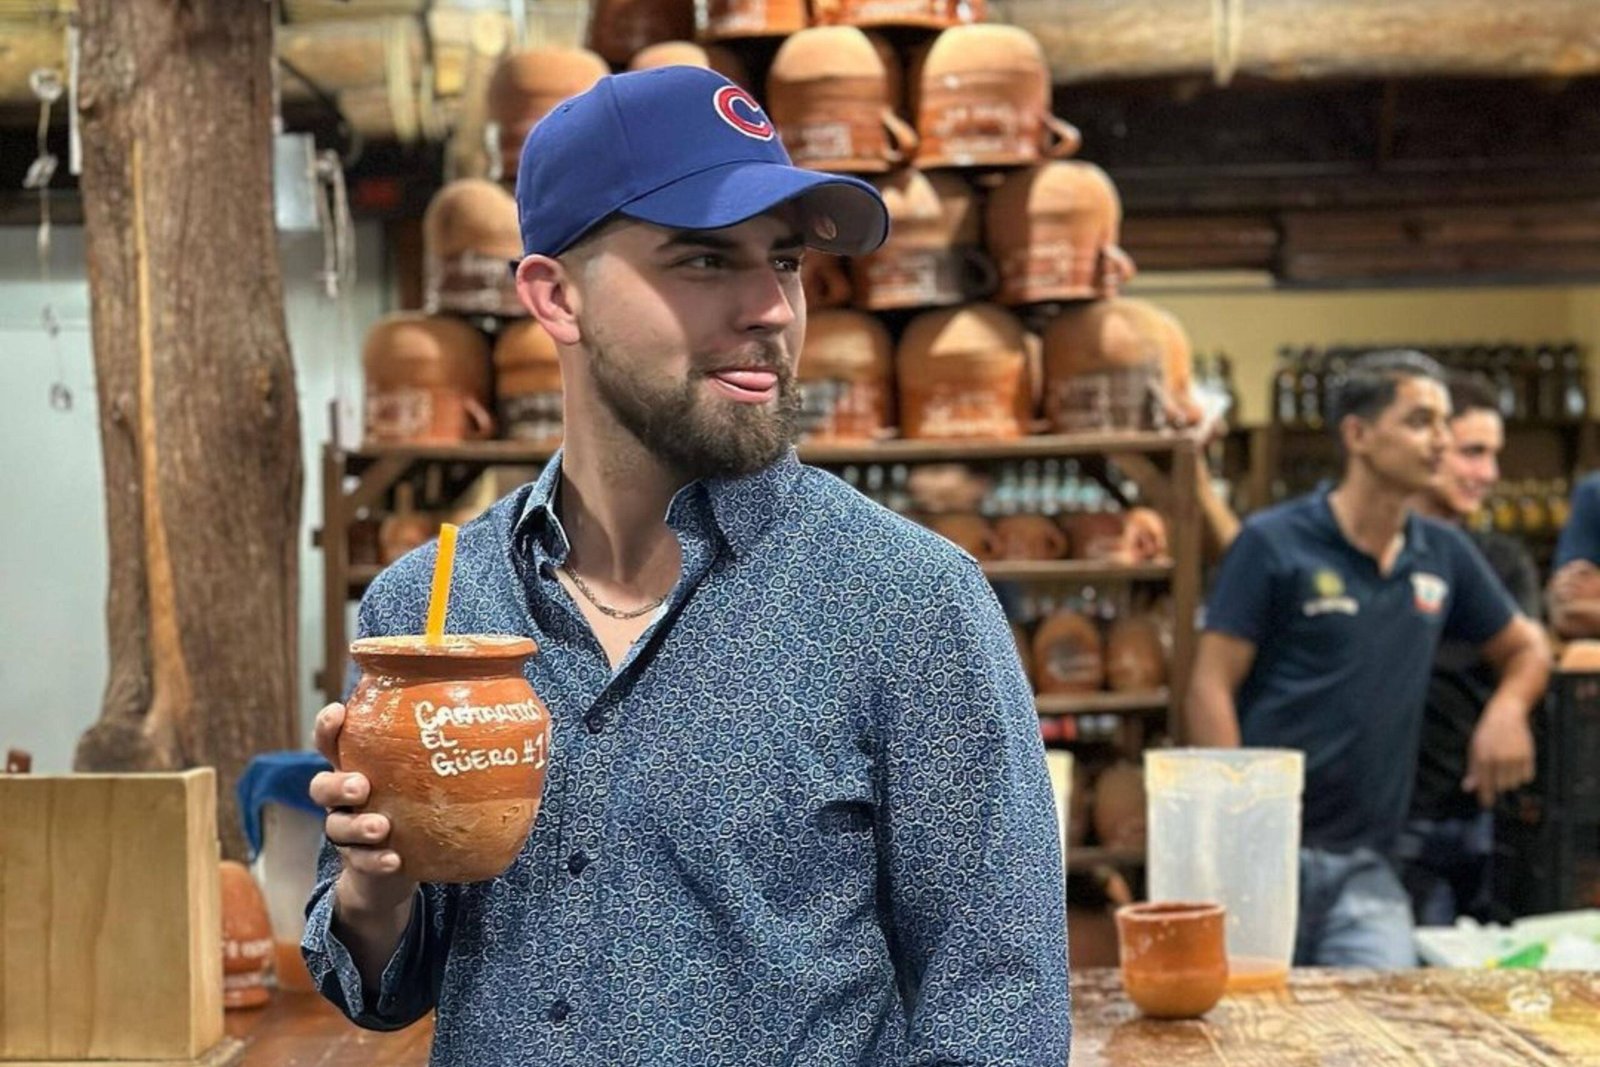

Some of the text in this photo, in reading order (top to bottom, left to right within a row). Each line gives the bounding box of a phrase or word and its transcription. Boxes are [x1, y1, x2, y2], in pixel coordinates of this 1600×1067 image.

[713, 85, 774, 141] C
[421, 729, 458, 750] EL
[430, 732, 547, 777] GÜERO #1
